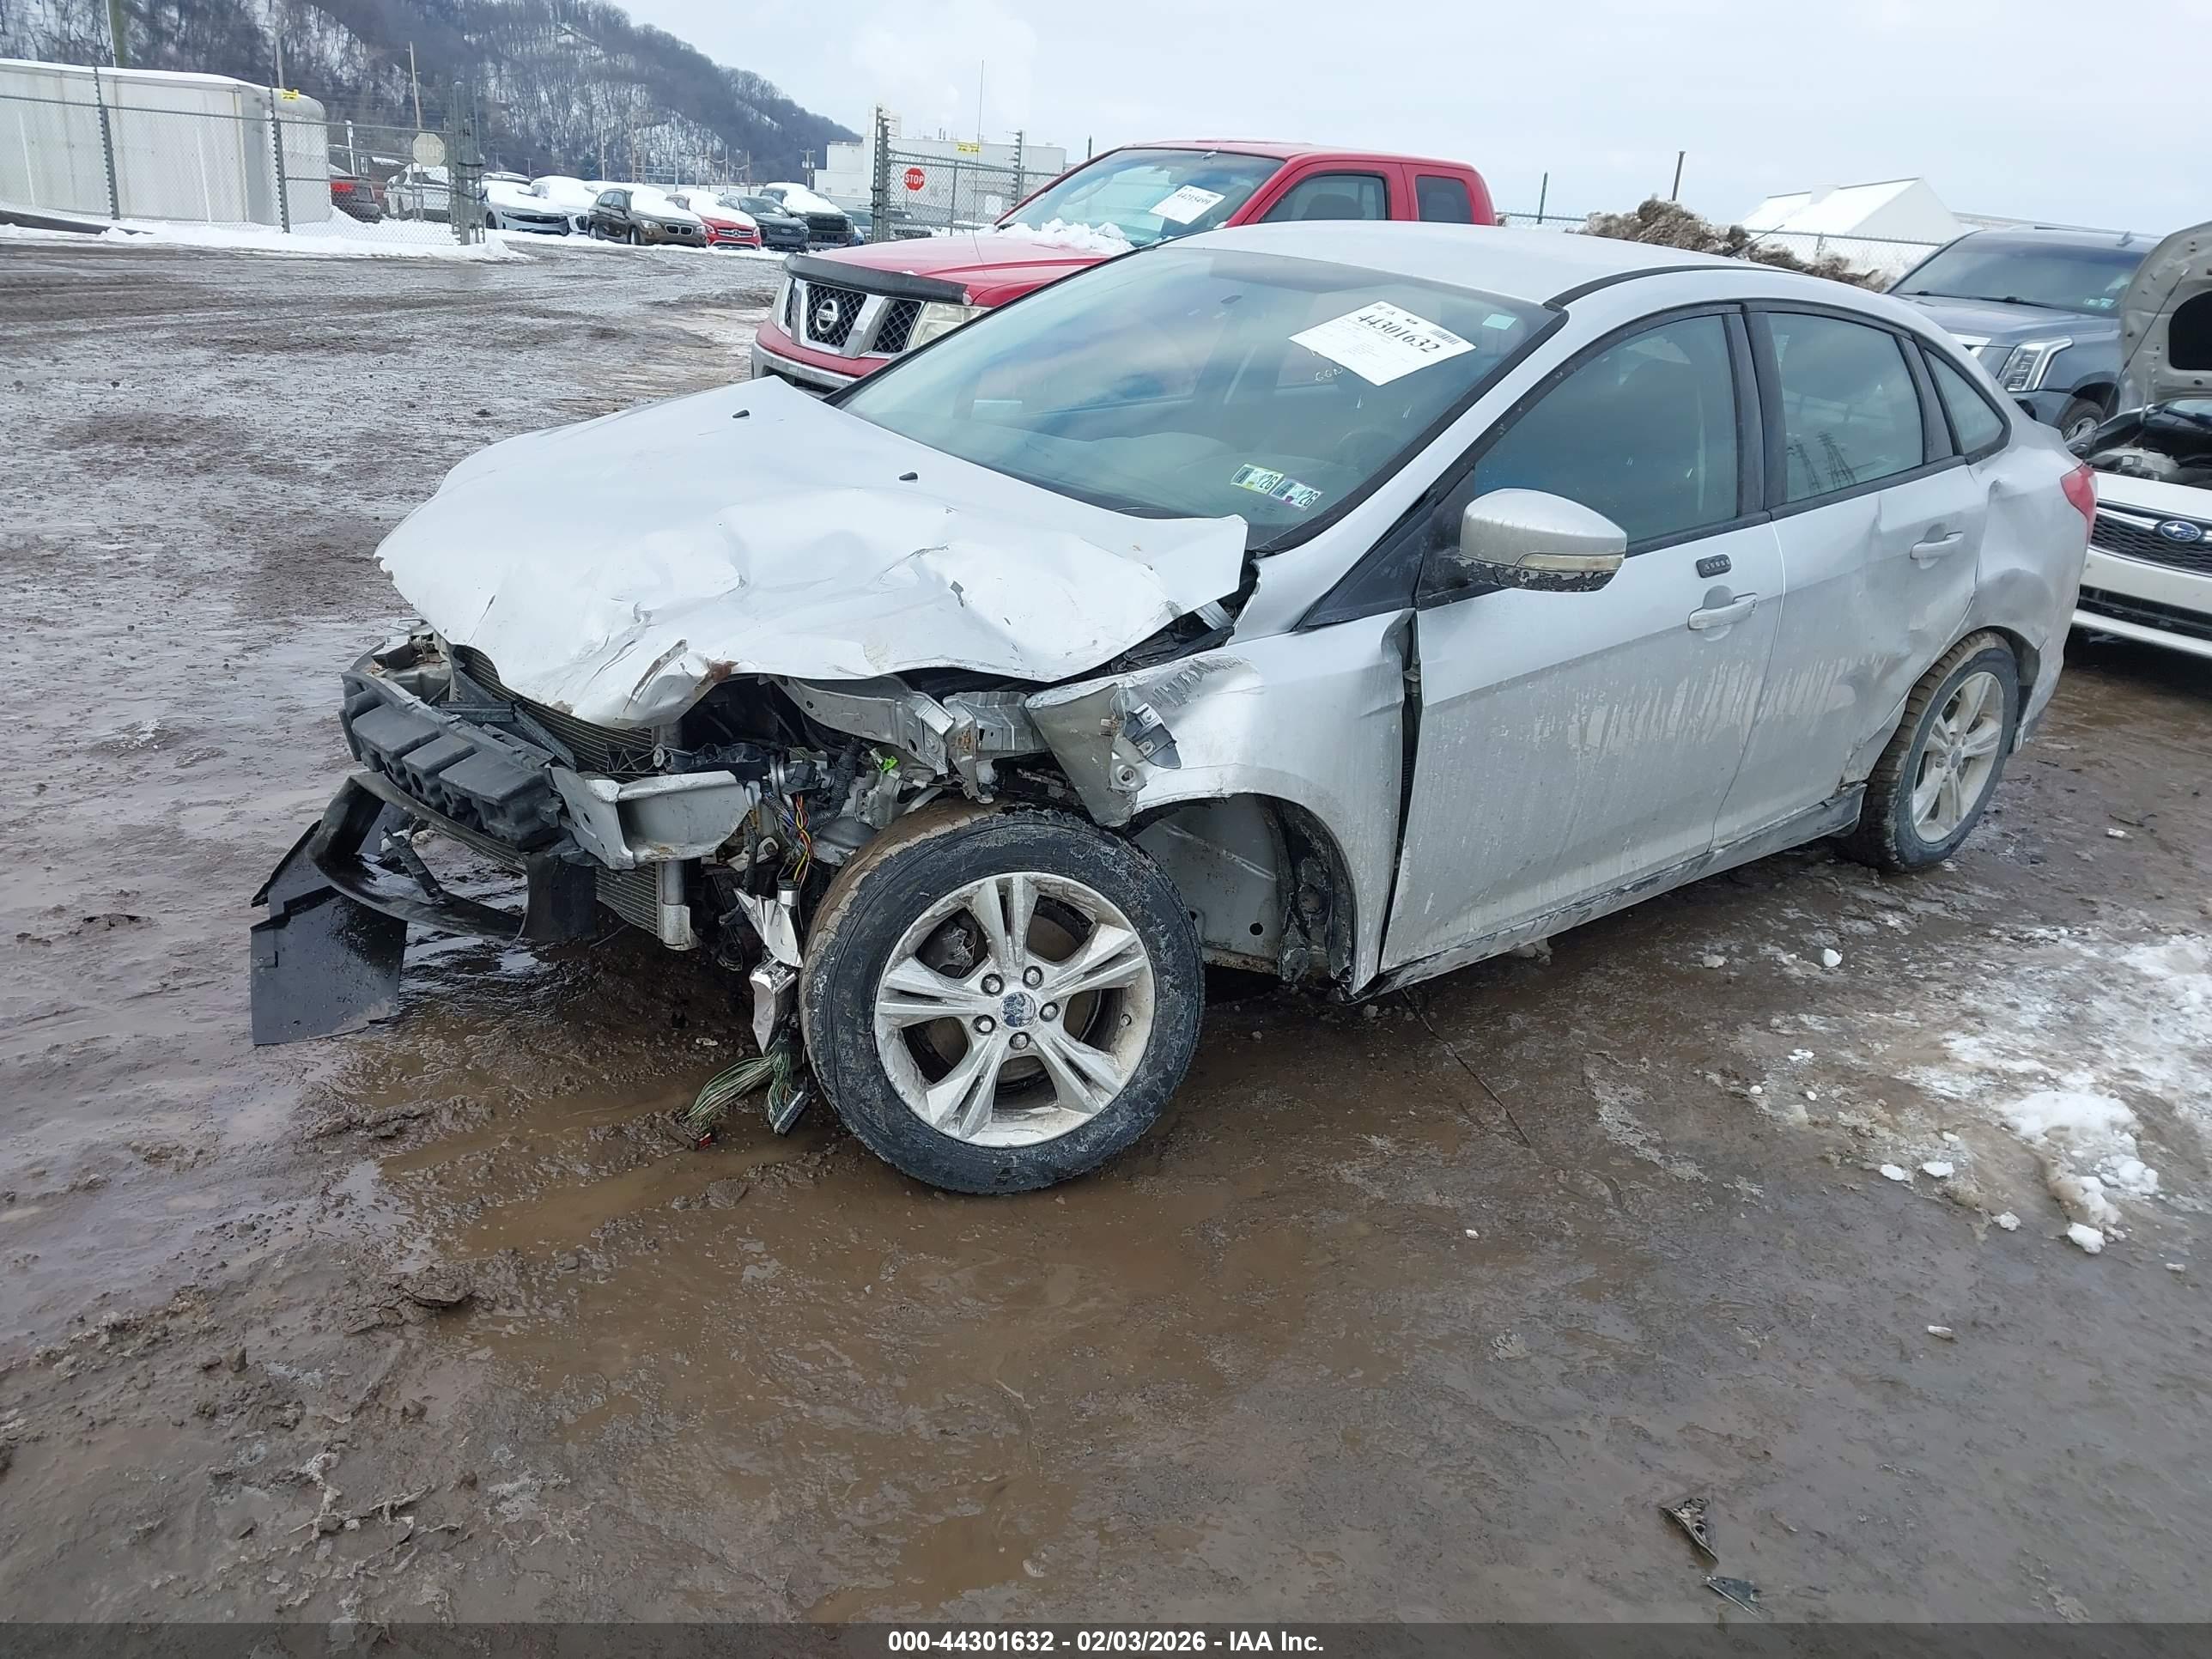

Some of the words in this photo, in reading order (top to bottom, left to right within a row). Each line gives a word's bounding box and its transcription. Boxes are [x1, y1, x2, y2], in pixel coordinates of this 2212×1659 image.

[416, 144, 441, 157] STOP
[904, 173, 925, 185] STOP
[1358, 314, 1441, 353] 44301632
[1259, 474, 1279, 490] 26
[1298, 490, 1320, 507] 26
